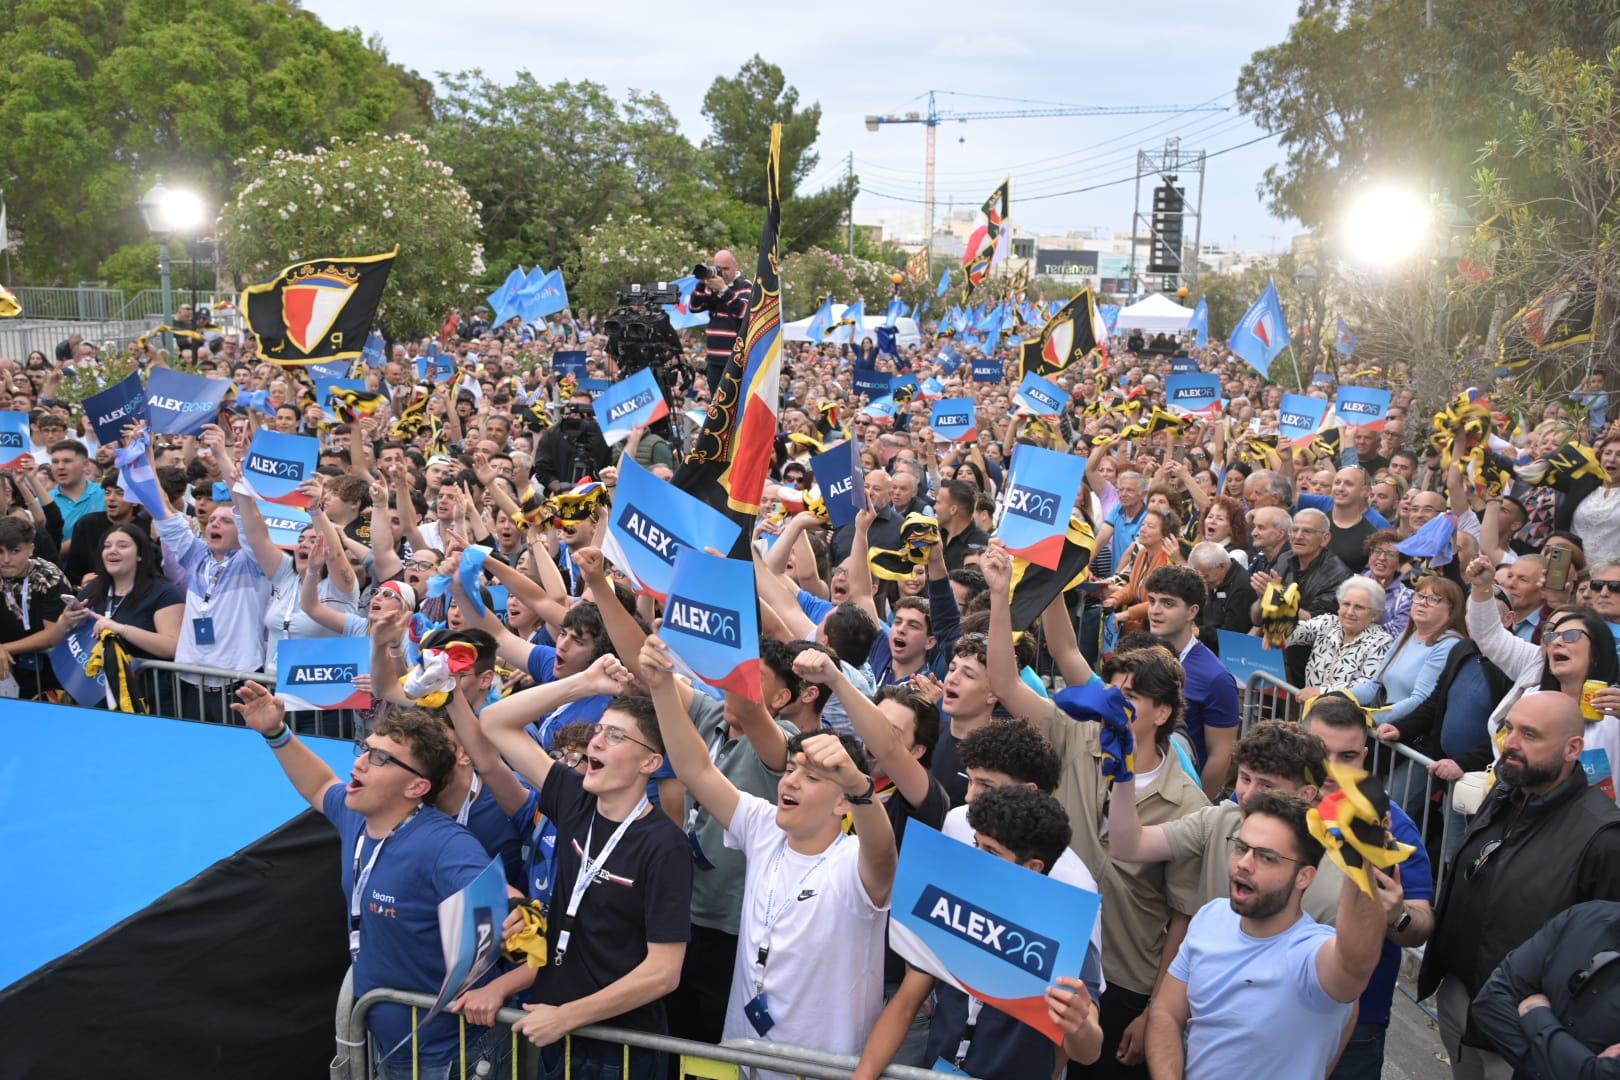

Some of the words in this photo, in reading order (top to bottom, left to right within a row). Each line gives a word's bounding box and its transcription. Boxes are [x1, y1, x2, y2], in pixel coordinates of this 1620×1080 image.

[1028, 388, 1058, 409] ALEX26
[1178, 388, 1213, 398] ALEX26
[147, 395, 213, 412] ALEXBORG
[611, 392, 652, 420] ALEX26
[1342, 402, 1378, 415] ALEX26
[938, 414, 968, 424] ALEX26
[1281, 413, 1311, 428] ALEX26
[0, 433, 20, 446] 26
[250, 455, 299, 478] ALEX26
[264, 517, 308, 530] ALEX2
[627, 512, 679, 560] ALEX2
[671, 601, 735, 641] ALEX26
[67, 633, 106, 687] ALEXBG
[295, 666, 354, 682] ALEX26
[372, 889, 395, 904] team
[930, 896, 1047, 971] ALEX26
